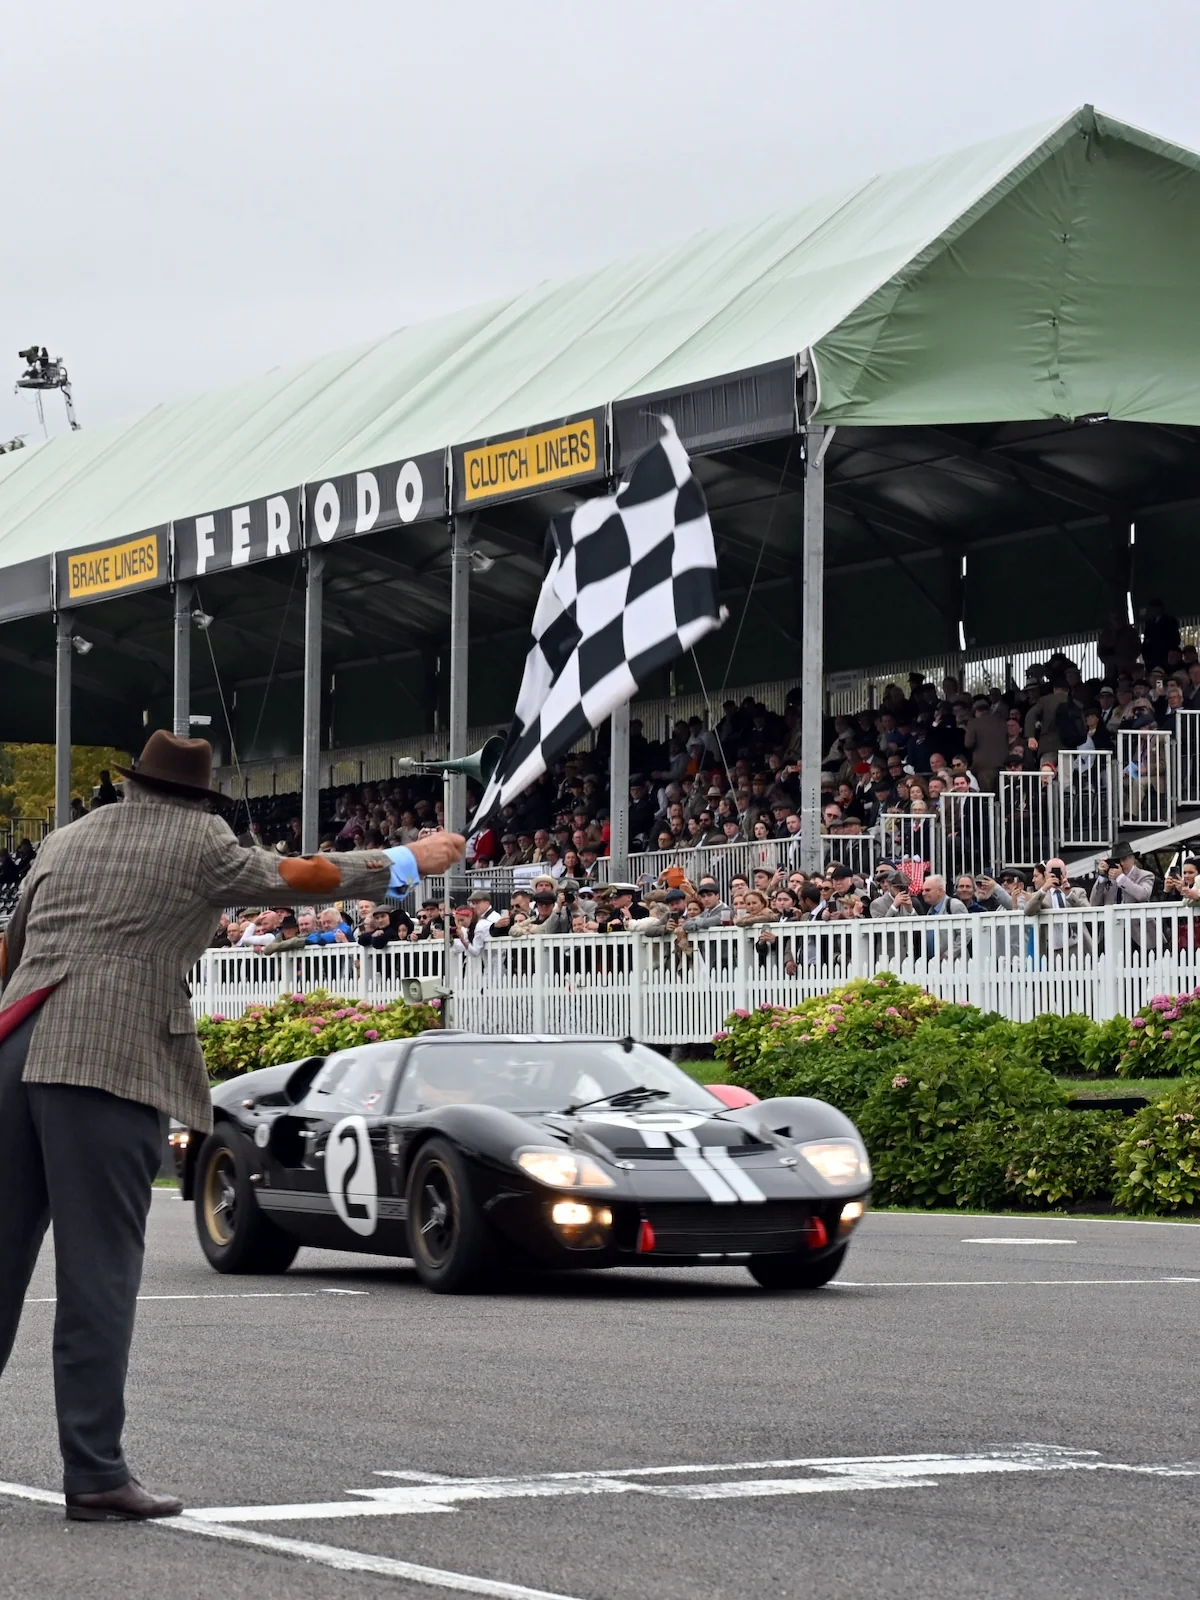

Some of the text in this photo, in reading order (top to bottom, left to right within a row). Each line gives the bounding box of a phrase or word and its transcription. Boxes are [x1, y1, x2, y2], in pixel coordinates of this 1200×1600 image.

[470, 429, 591, 490] CLUTCH LINERS
[195, 460, 424, 575] FERODO
[72, 544, 154, 589] BRAKE LINERS
[338, 1124, 372, 1220] 2
